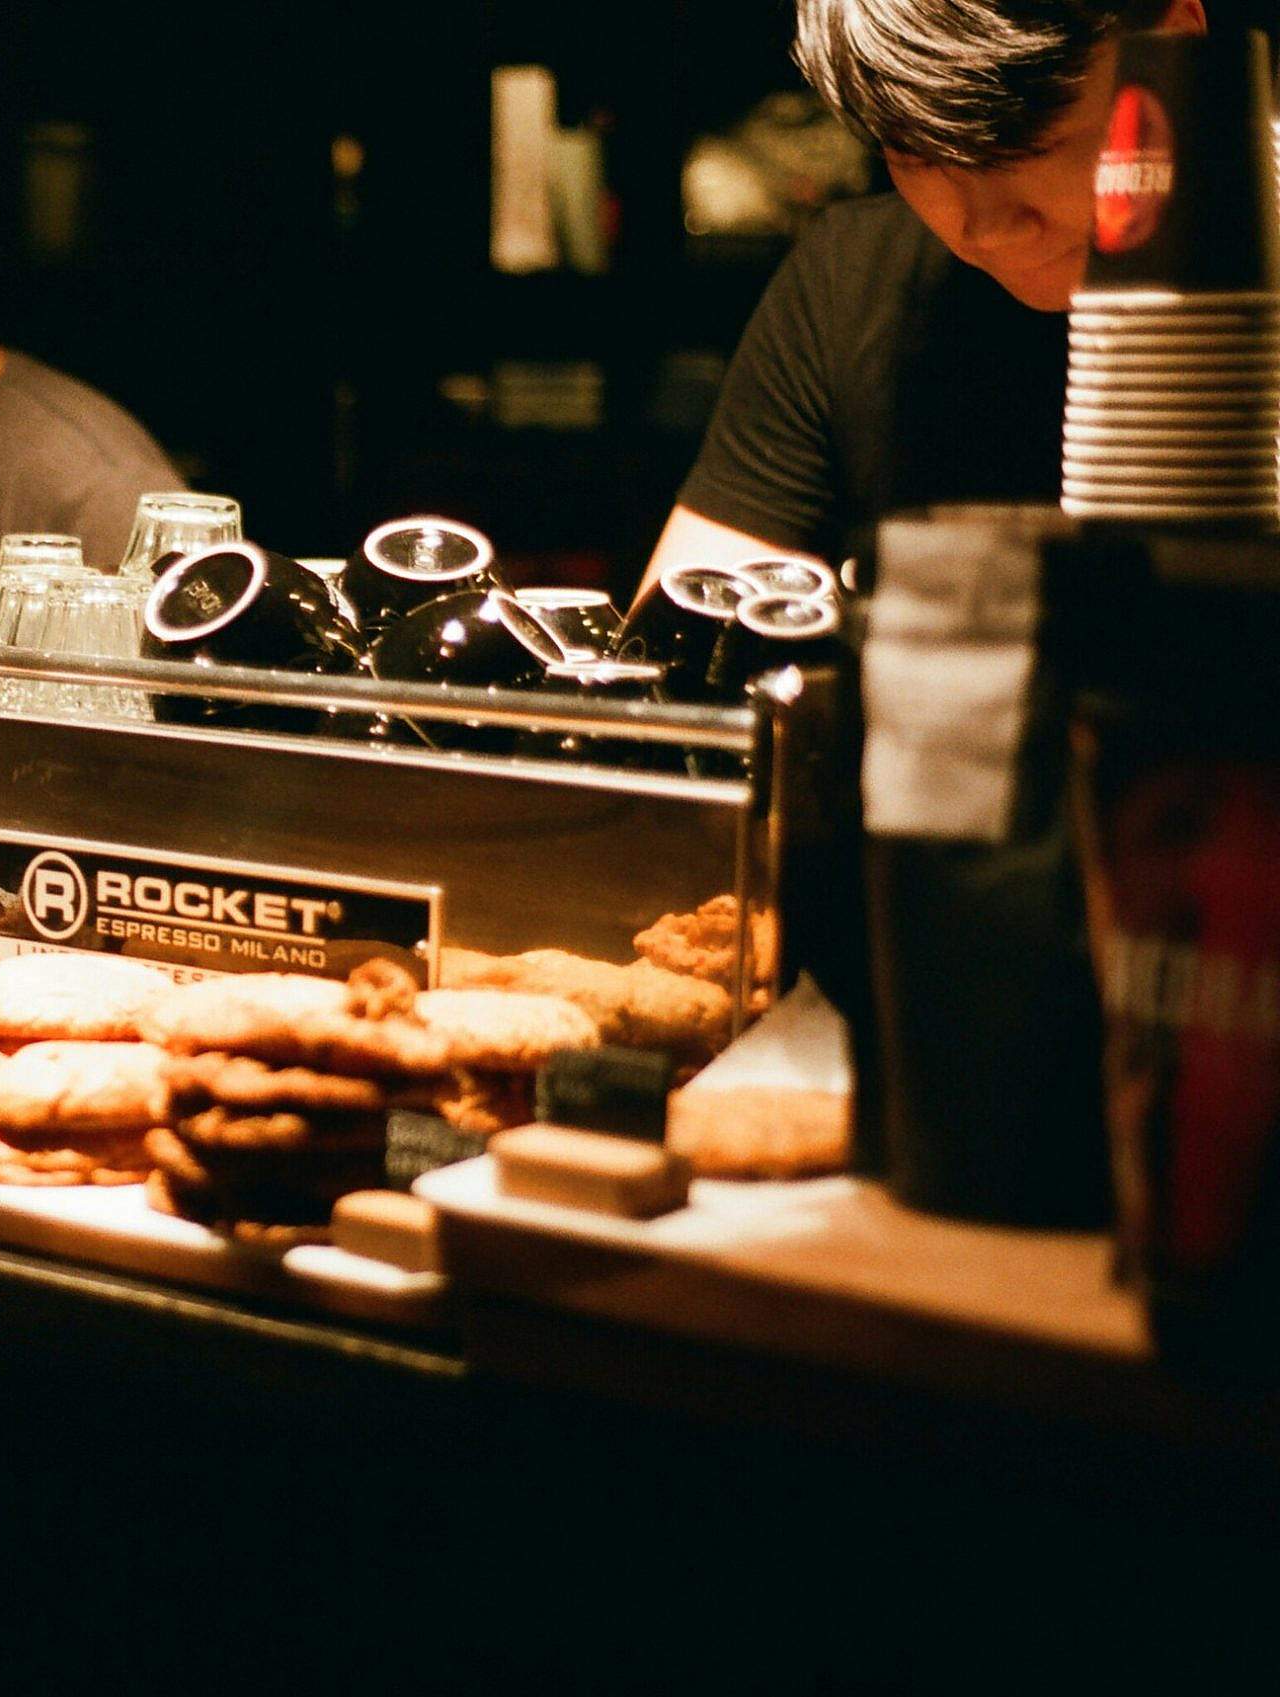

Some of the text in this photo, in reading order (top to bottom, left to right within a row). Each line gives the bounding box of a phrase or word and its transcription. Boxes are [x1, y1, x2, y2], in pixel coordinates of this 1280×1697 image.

[97, 870, 327, 935] ROCKET
[96, 917, 327, 969] ESPRESSO MILANO
